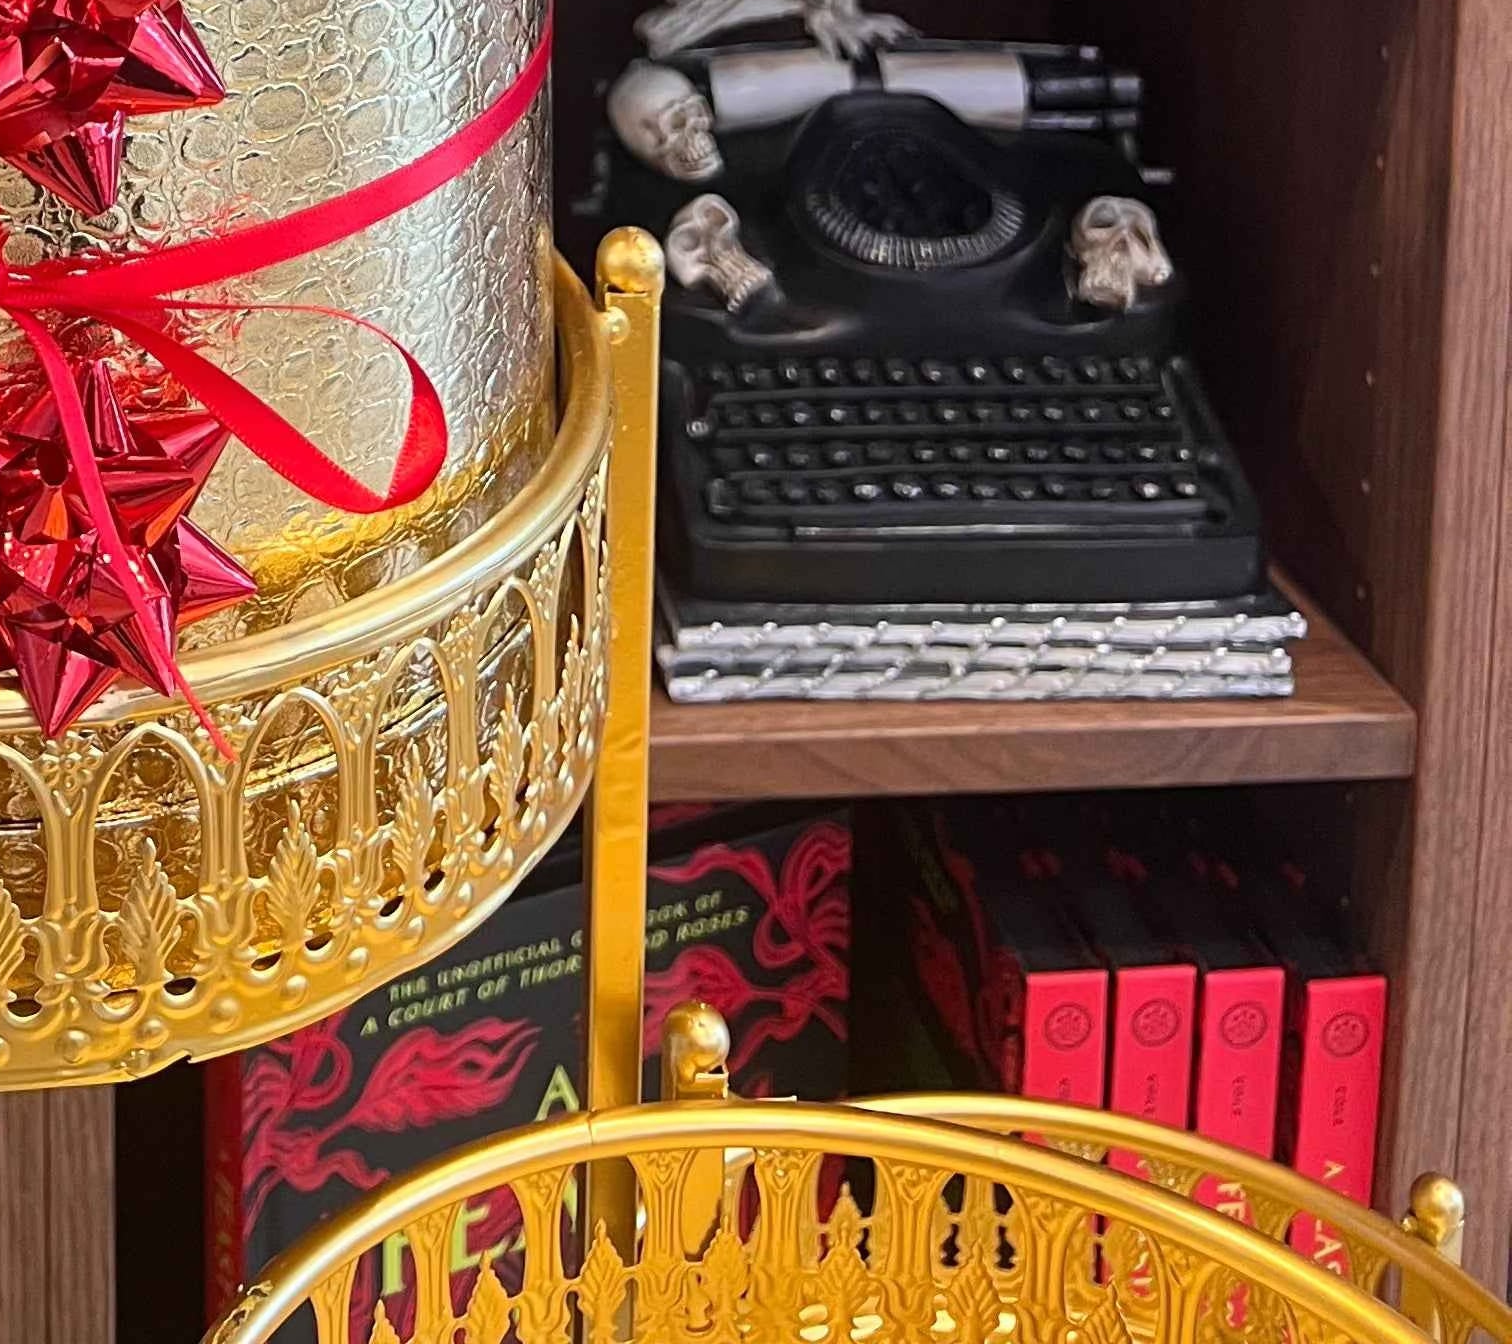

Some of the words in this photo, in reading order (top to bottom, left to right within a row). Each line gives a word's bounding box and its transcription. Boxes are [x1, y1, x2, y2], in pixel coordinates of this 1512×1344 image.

[388, 976, 428, 1002] THE
[436, 937, 560, 988] UNOFFICIAL
[387, 985, 469, 1029] COURT
[476, 975, 510, 1001] OF
